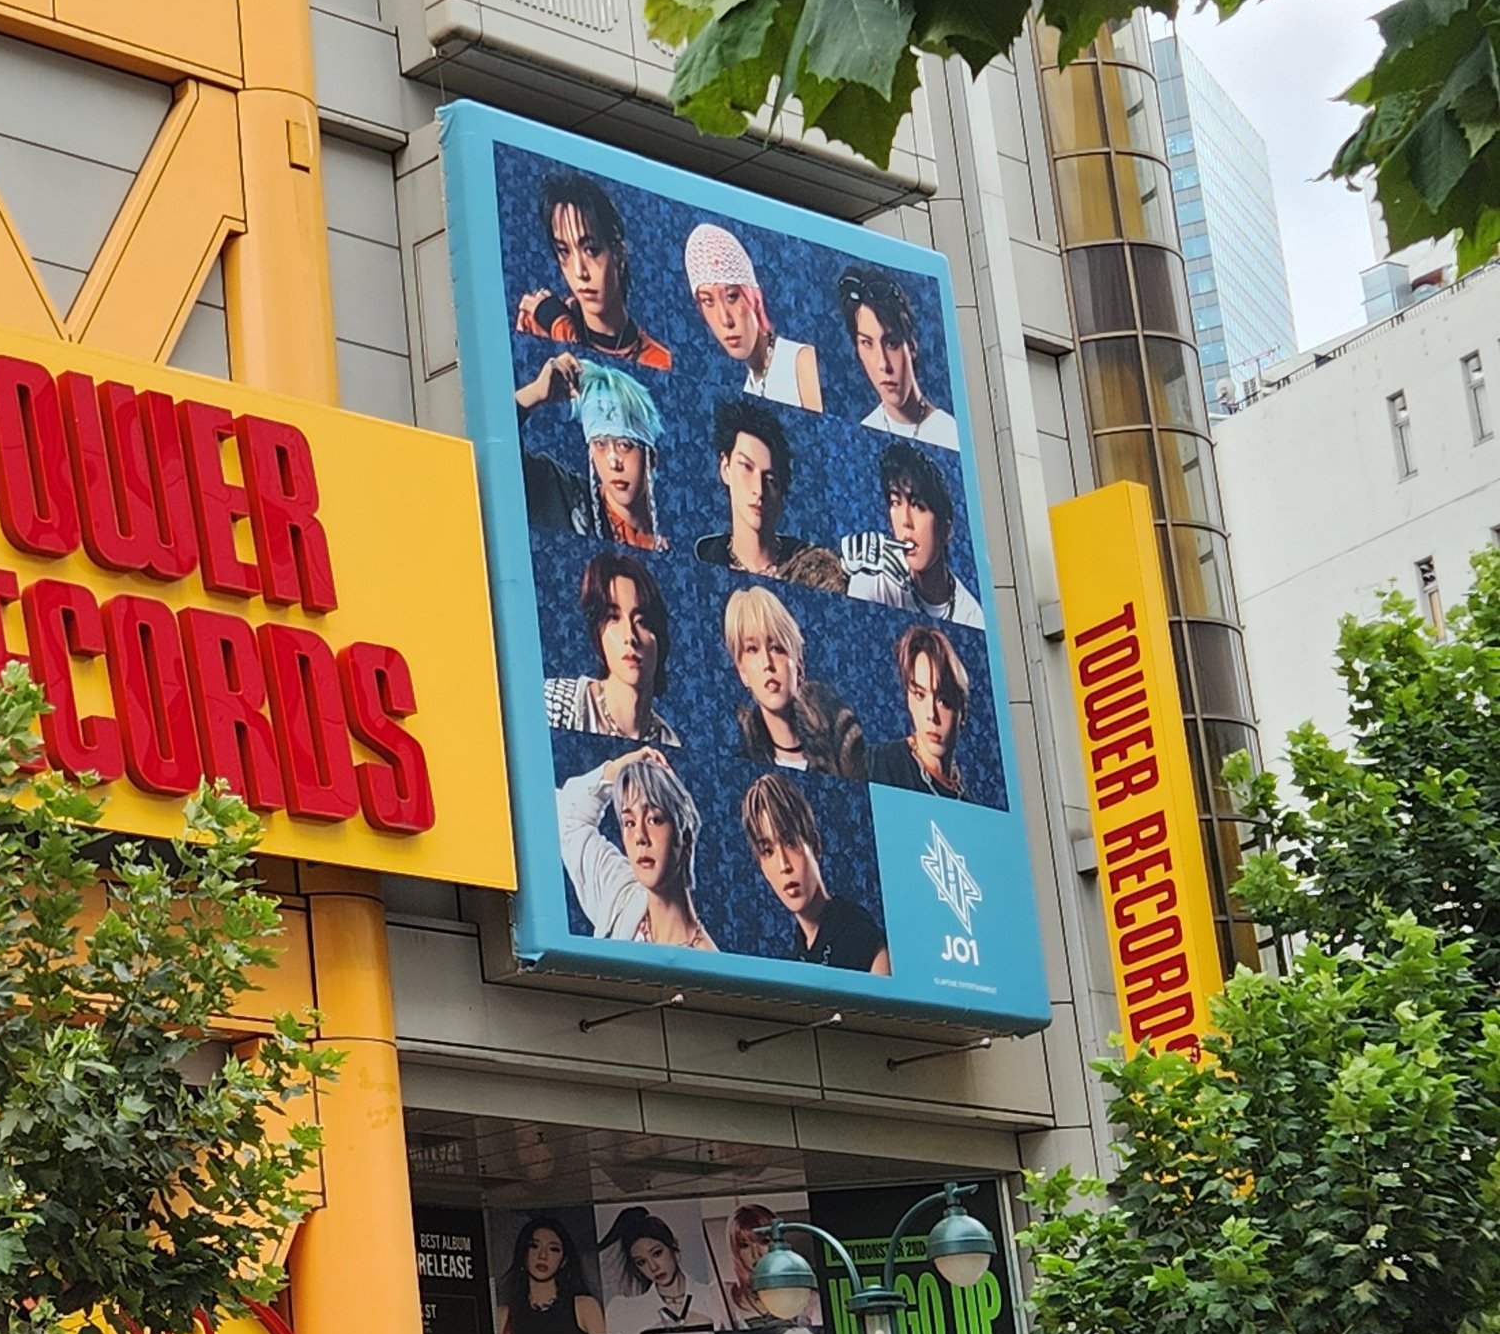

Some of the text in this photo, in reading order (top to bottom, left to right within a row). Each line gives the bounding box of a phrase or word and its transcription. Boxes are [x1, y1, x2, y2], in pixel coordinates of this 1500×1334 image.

[1074, 602, 1160, 812] TOWER
[941, 934, 980, 966] JO1
[420, 1233, 471, 1252] BEST ALBUM
[417, 1253, 474, 1280] RELEASE
